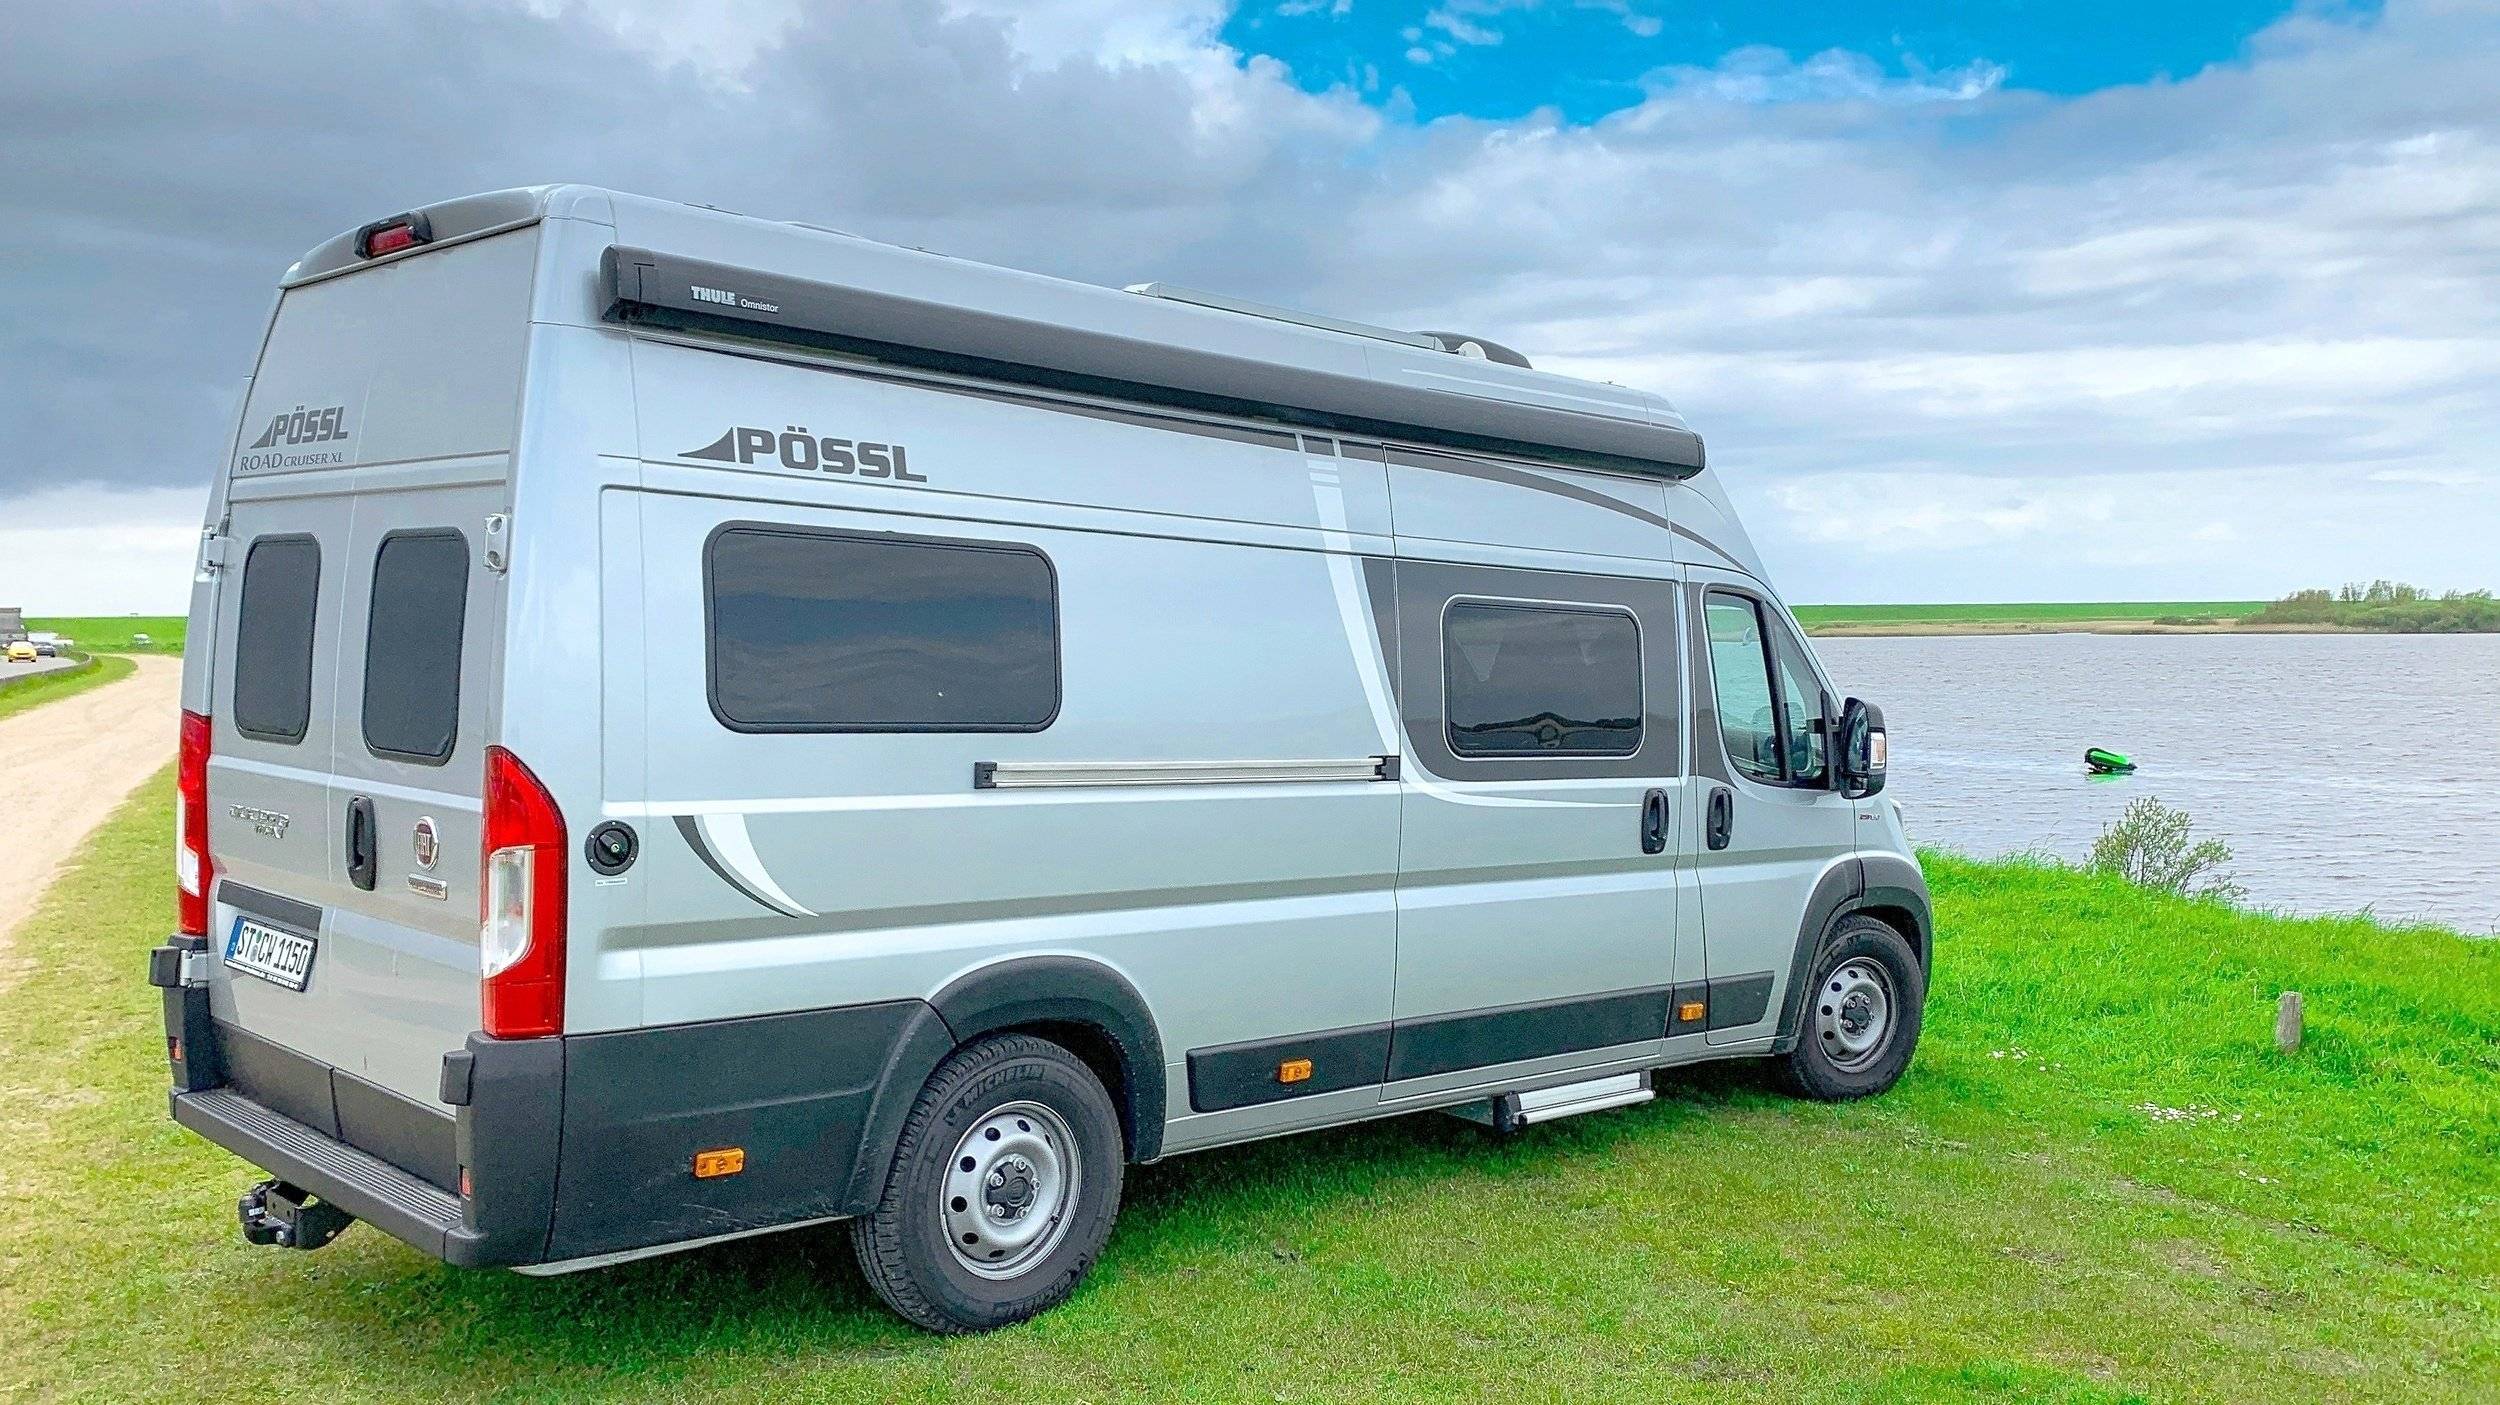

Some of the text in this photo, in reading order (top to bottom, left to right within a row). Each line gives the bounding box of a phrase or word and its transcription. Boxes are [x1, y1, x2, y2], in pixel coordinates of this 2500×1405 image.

[691, 285, 779, 313] THULE Omnistor
[270, 405, 348, 447] PÖSSL
[240, 451, 344, 471] ROAD CRUISER XL
[736, 425, 928, 483] PÖSSL
[273, 938, 309, 976] 1150
[963, 1064, 1047, 1107] MICHELIN
